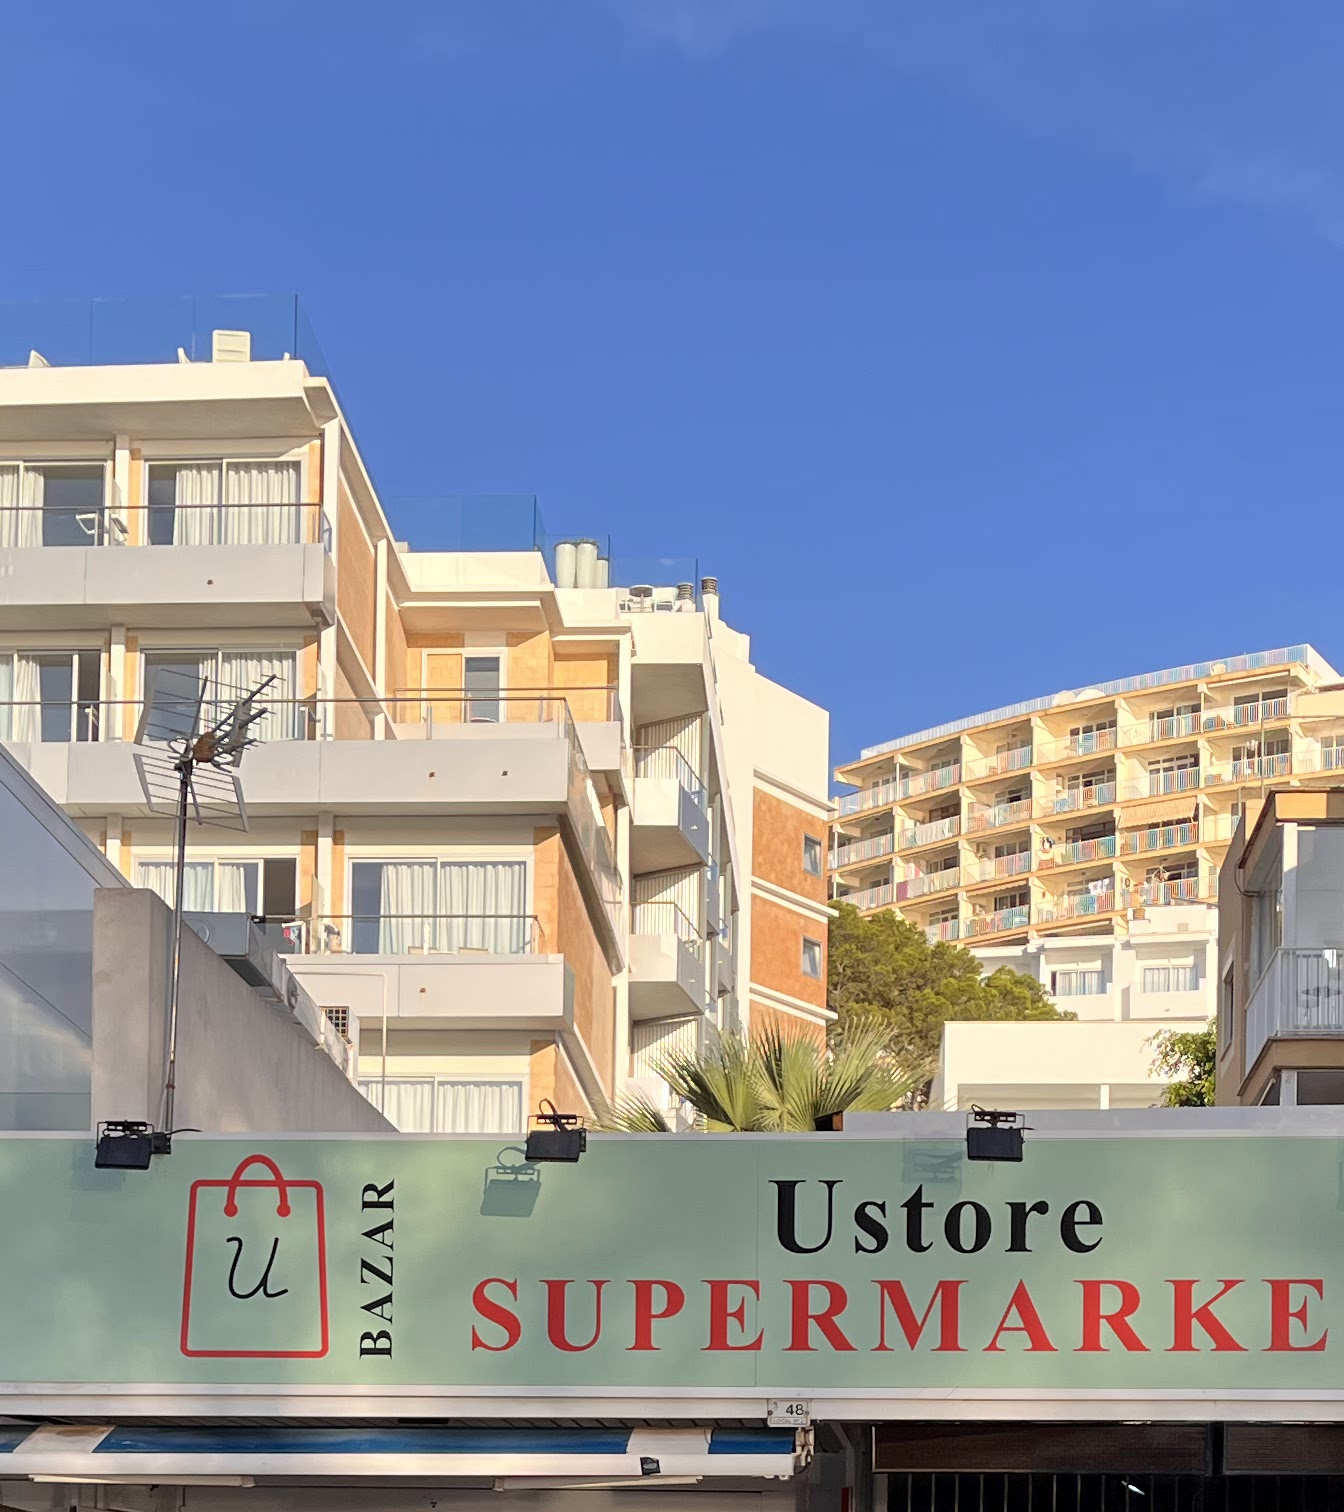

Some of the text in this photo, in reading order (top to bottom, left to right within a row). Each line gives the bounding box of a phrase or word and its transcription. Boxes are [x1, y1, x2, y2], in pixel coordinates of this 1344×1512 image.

[769, 1178, 1105, 1254] Ustore
[359, 1178, 394, 1360] BAZAR
[786, 1404, 803, 1415] 48
